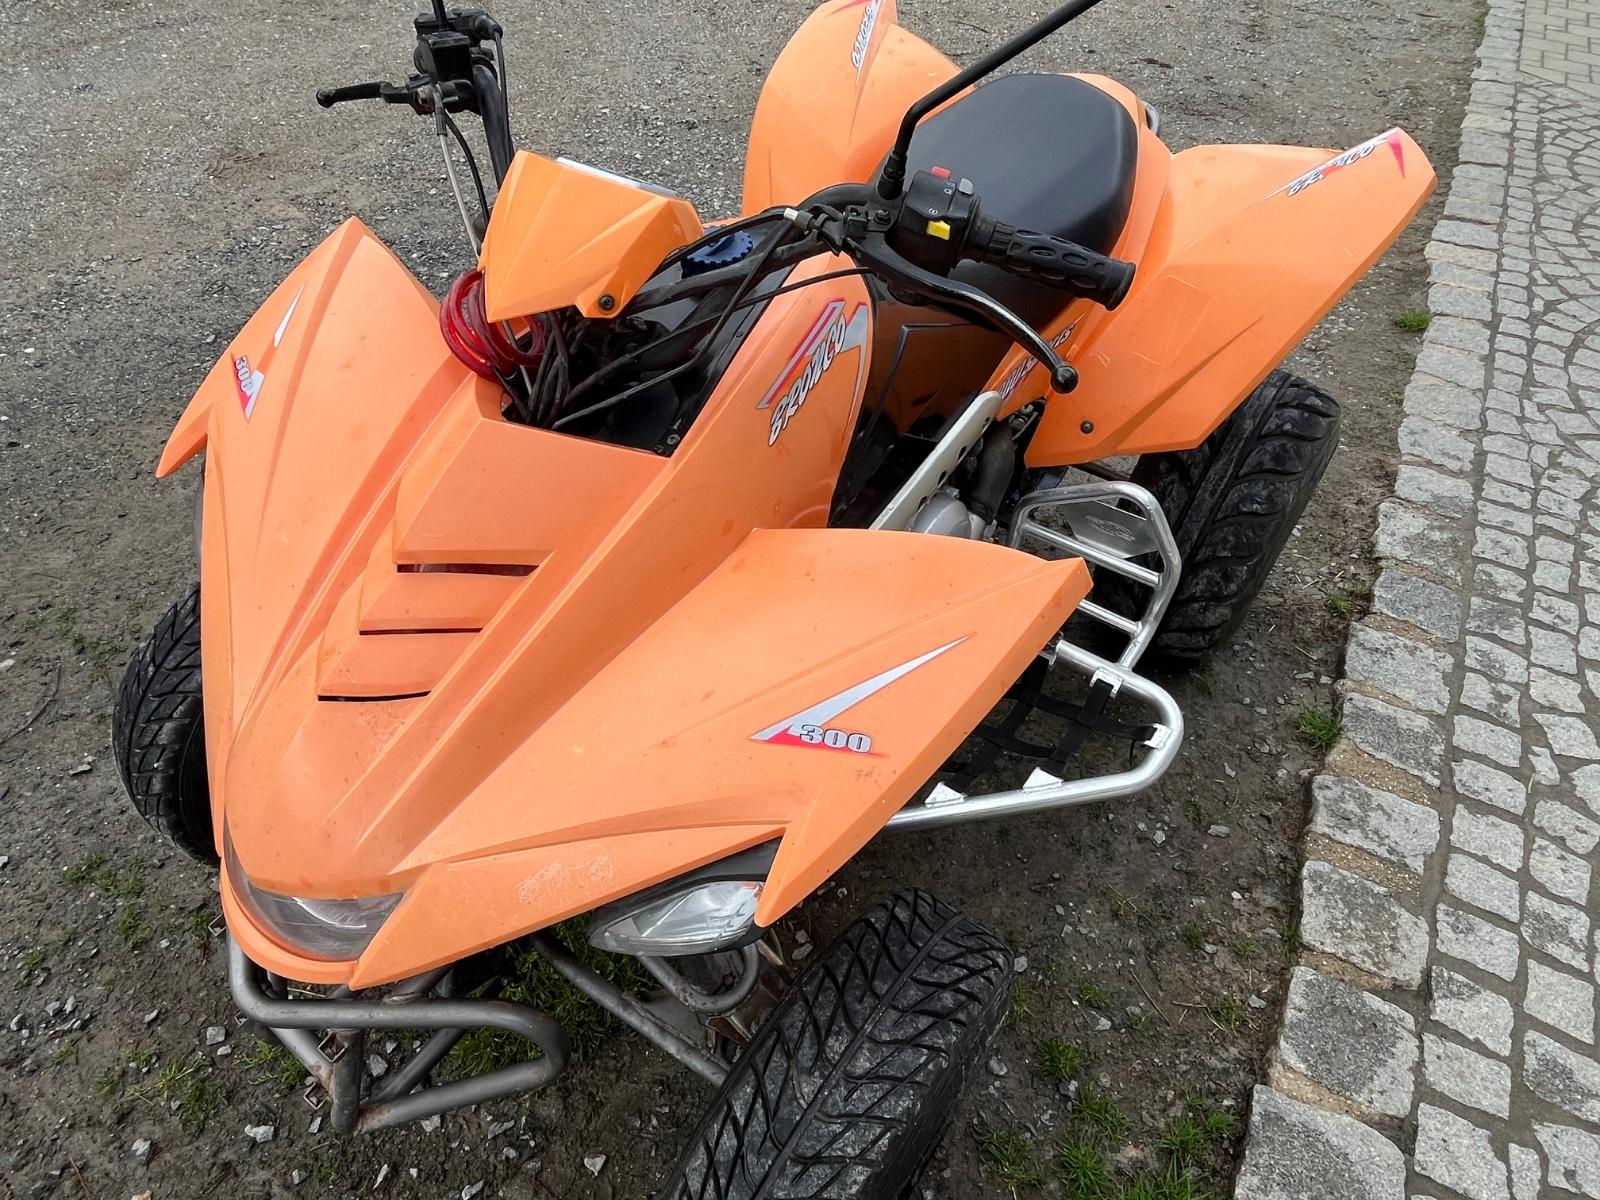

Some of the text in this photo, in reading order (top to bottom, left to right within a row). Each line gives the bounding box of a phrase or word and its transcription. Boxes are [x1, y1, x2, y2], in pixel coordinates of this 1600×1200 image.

[1287, 143, 1376, 197] BRNCO
[234, 355, 254, 392] 300
[768, 314, 847, 447] BRONCO
[799, 724, 872, 753] 300
